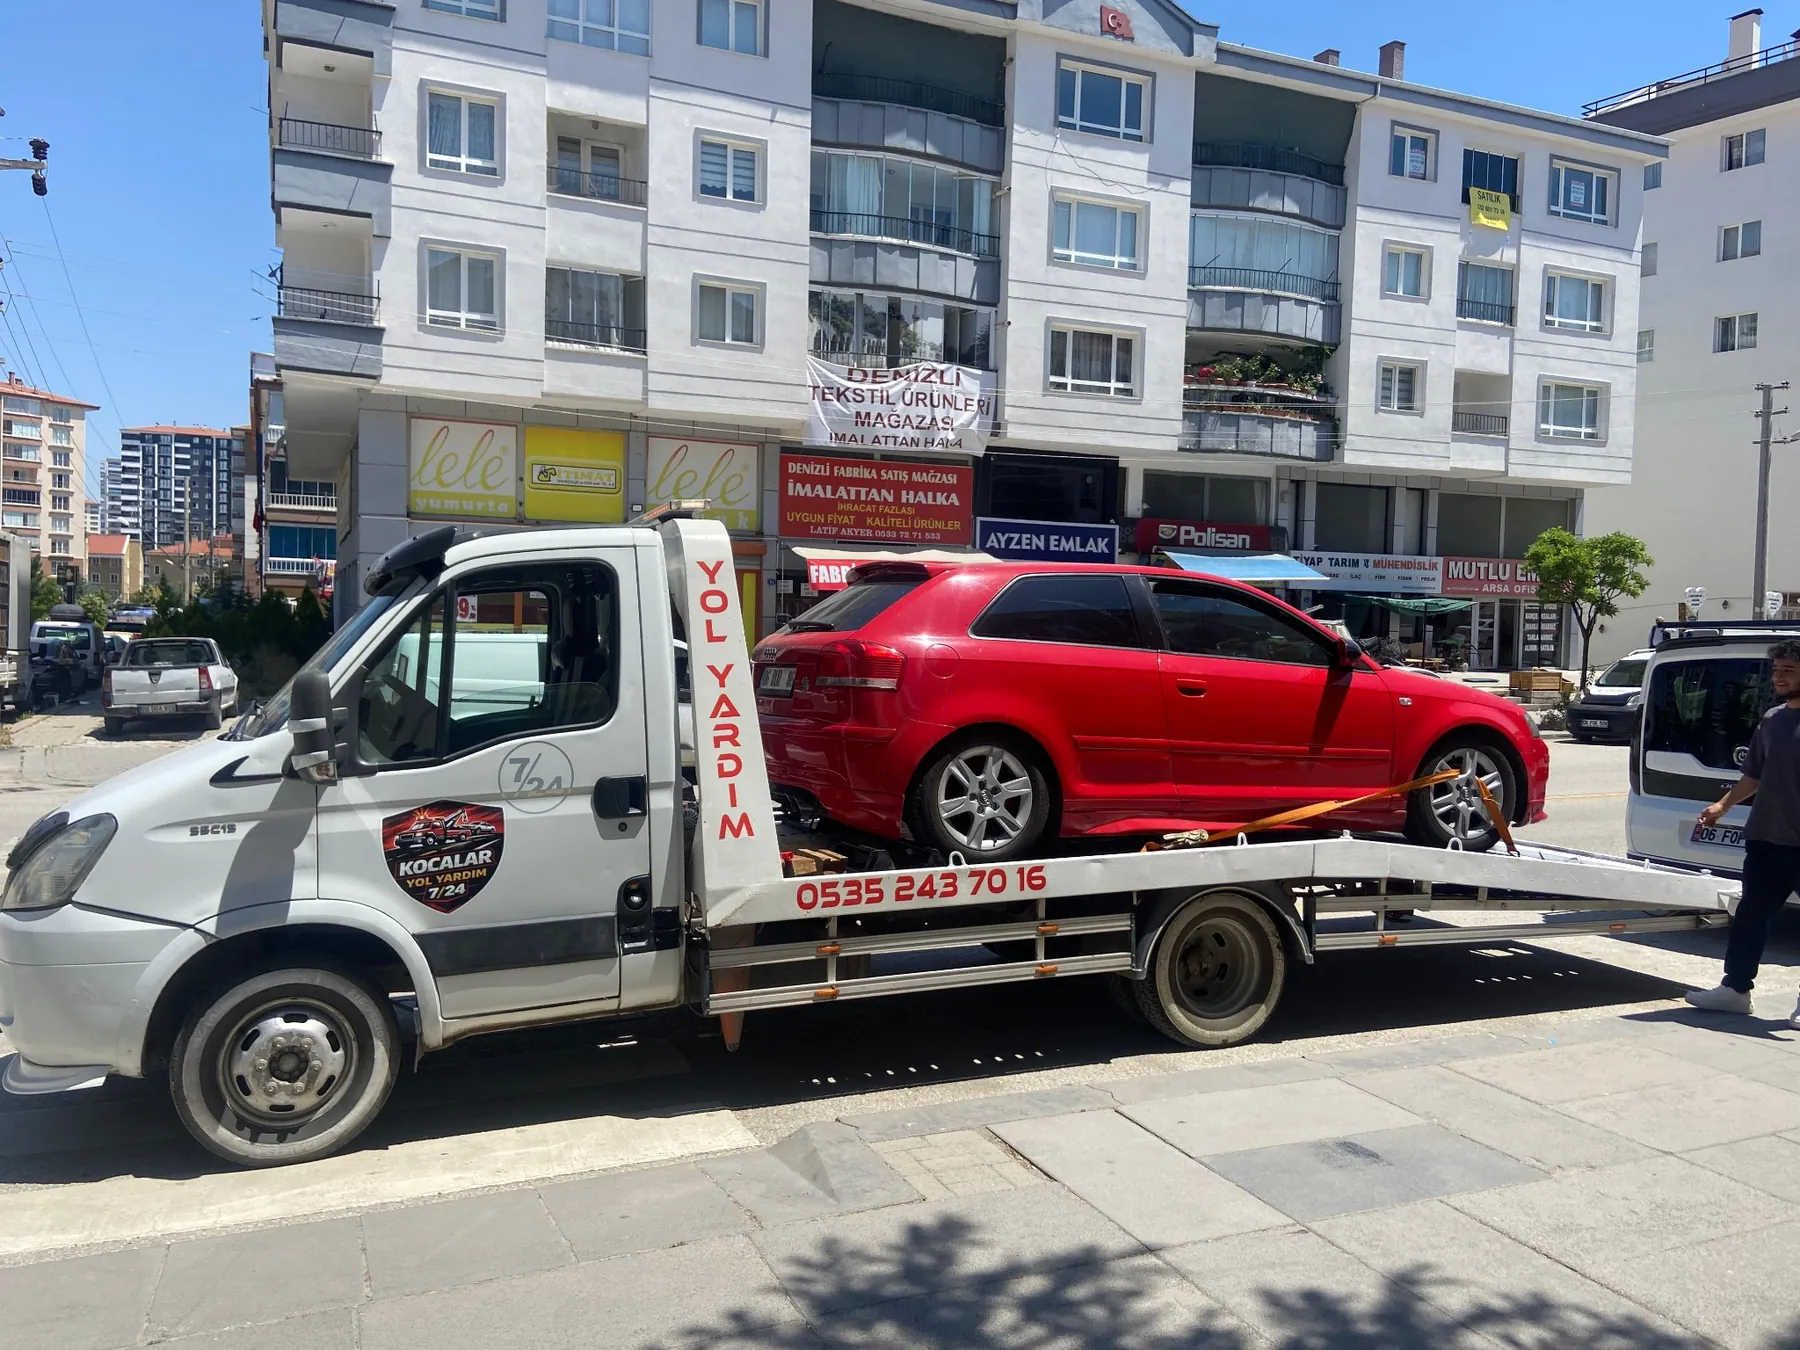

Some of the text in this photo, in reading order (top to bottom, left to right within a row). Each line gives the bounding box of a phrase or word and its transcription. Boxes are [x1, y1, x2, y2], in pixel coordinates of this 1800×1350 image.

[1477, 190, 1501, 204] SATILIK
[808, 385, 991, 416] TEKSTİL ÜRÜNLERİ
[855, 408, 954, 433] MAĞAZASI
[788, 461, 958, 485] DENİZLİ FABRİKA SATIŞ MAĞZASI
[787, 479, 960, 506] İMALATTAN HALKA
[415, 497, 509, 512] yumurta
[837, 501, 915, 515] İHRACAT FAZLASI
[787, 511, 961, 530] UYGUN FİYAT KALİTELİ ÜRÜNLER
[809, 524, 941, 540] LATİF AKYER 0533 72 71 533
[985, 532, 1110, 553] AYZEN EMLAK
[1179, 525, 1249, 549] Polisan
[809, 562, 856, 583] FABR
[1328, 556, 1360, 568] TARIM
[1372, 556, 1439, 571] MÜHENDİSLİK
[1447, 561, 1540, 582] MUTLU EM
[1482, 583, 1510, 593] ARSA
[696, 560, 729, 642] YOL
[706, 663, 754, 840] YARDIM
[1701, 827, 1718, 841] 06
[400, 849, 493, 876] KOCALAR
[406, 868, 487, 888] YOL YARDIM
[796, 865, 1047, 910] 0535 243 70 16
[428, 883, 466, 899] 7/24
